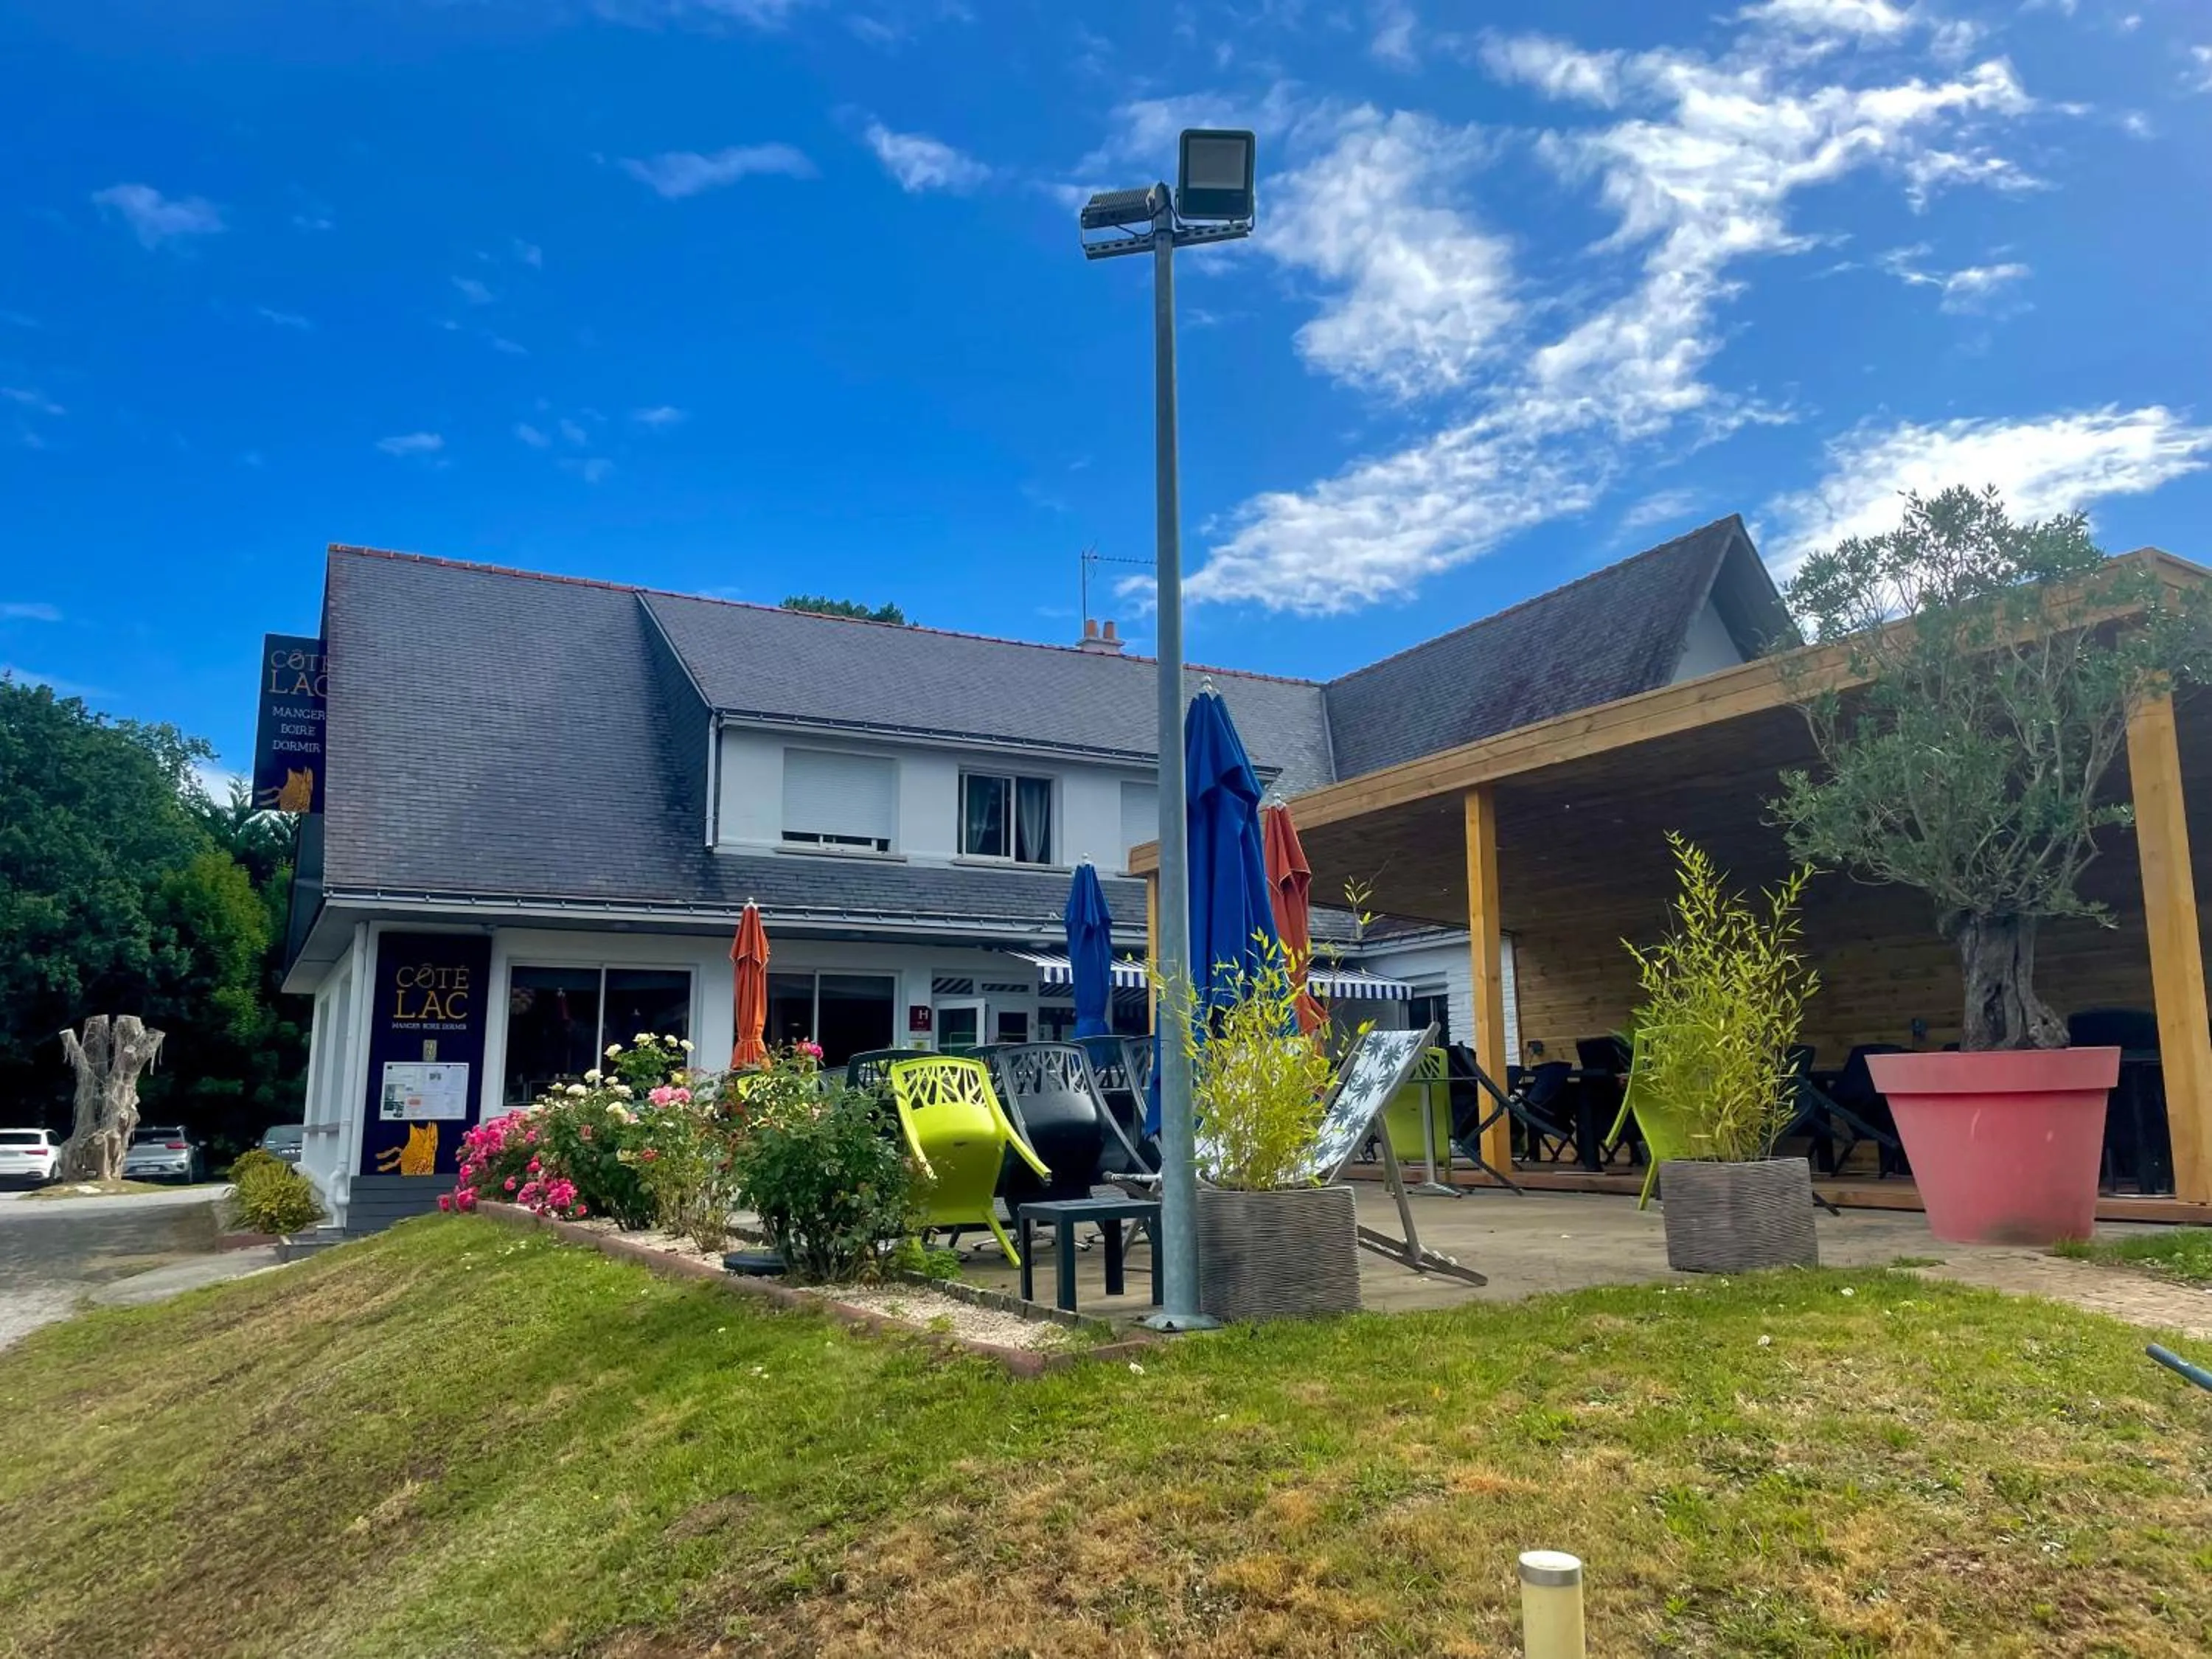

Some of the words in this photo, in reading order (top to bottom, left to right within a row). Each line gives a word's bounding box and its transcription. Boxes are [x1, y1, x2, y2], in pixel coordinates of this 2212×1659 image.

[272, 705, 325, 720] MANGER
[281, 723, 316, 737] BOIRE
[272, 740, 321, 754] DORMIR
[393, 990, 469, 1020] LAC
[919, 1009, 928, 1020] H
